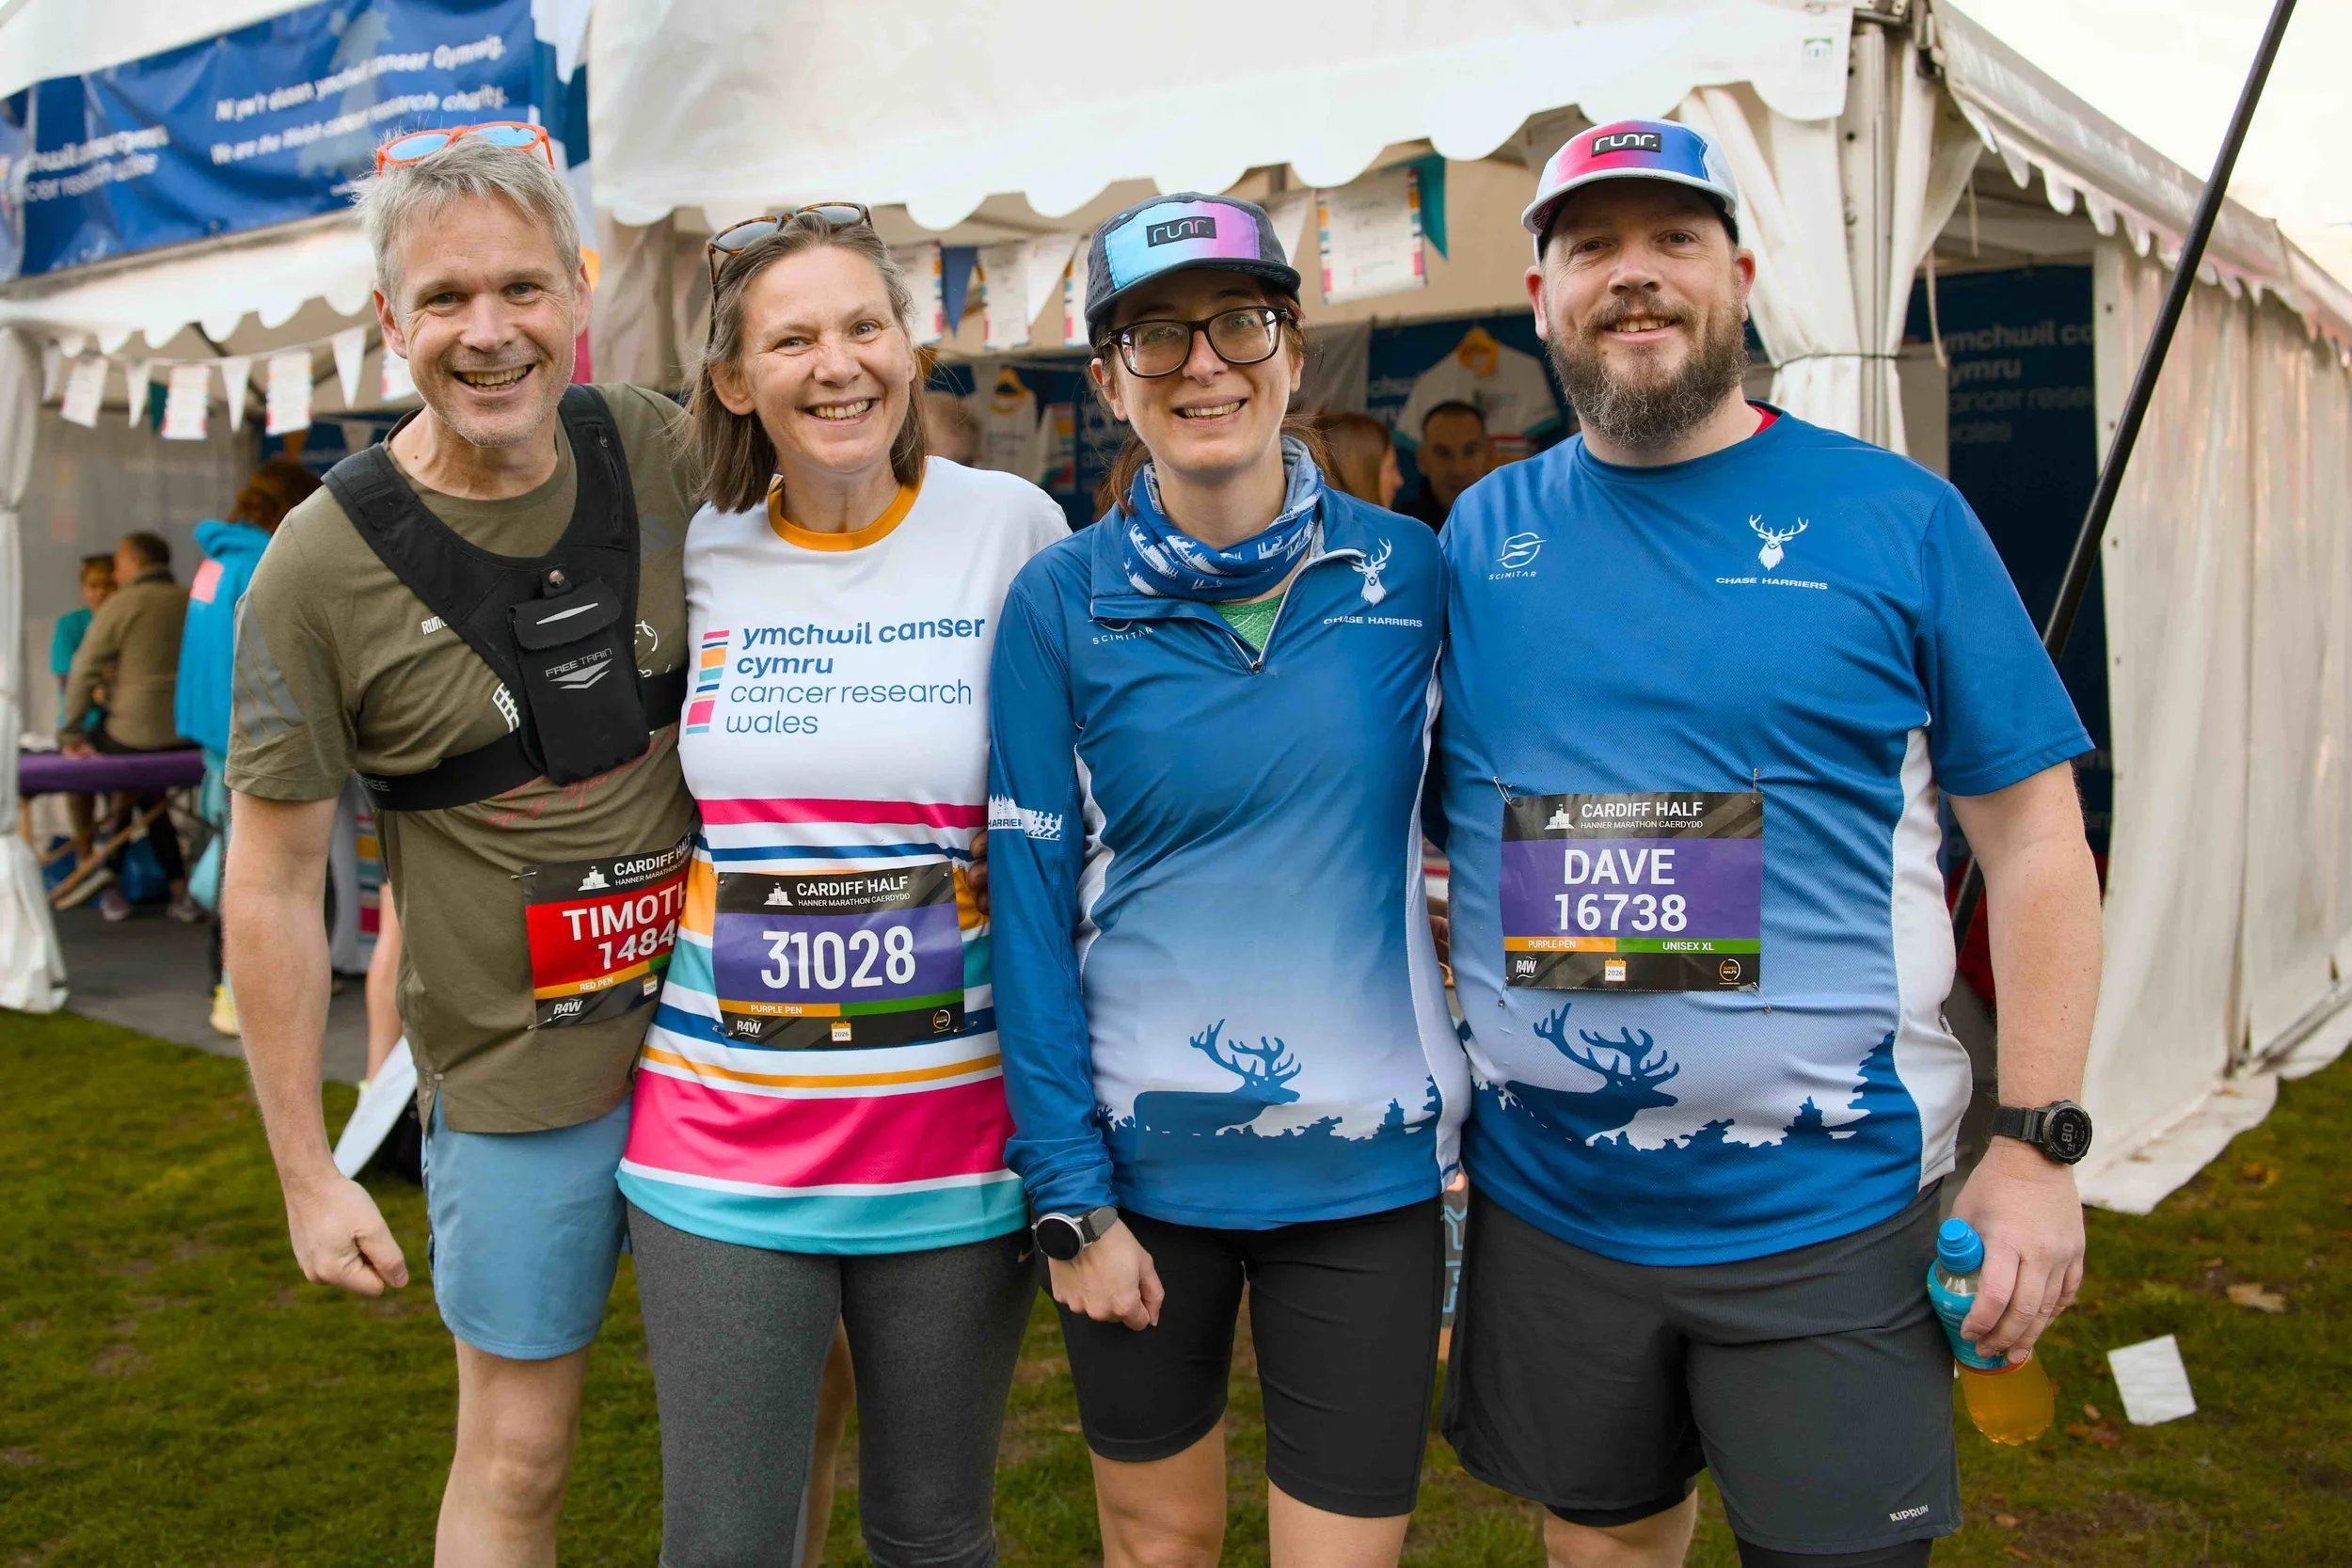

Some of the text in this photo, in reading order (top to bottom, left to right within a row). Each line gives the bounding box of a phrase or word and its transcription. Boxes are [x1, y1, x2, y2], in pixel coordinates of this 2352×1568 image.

[1488, 570, 1537, 580] SCIMITAR
[1715, 577, 1828, 590] CHASE HARRIERS
[1323, 616, 1423, 627] CHASE HARRIERS
[741, 618, 985, 650] ymchwil canser
[1092, 626, 1153, 645] SCIMITAR
[545, 647, 612, 677] FREE TRAIN
[737, 657, 834, 679] cymru
[730, 678, 972, 705] cancer research
[725, 710, 818, 734] wales
[1581, 801, 1703, 818] CARDIFF HALF
[1613, 820, 1658, 829] MARATHON
[1659, 820, 1703, 829] CAERDYDD
[613, 850, 675, 877] CARDIFF
[675, 832, 691, 860] HALF
[614, 864, 678, 886] HANNER MARATHON
[1564, 848, 1676, 885] DAVE
[796, 876, 909, 896] CARDIFF HALF
[798, 893, 911, 907] HANNER MARATHON CAERDYDD
[562, 880, 687, 942] TIMOTH
[1554, 894, 1688, 932] 16738
[597, 917, 677, 970] 1484
[1528, 940, 1576, 949] PURPLE PEN
[1662, 942, 1714, 951] UNISEX XL
[760, 926, 916, 990] 31028
[1607, 969, 1624, 977] 2026
[580, 976, 613, 991] RED PEN
[751, 1004, 803, 1014] PURPLE PEN
[1889, 1505, 1929, 1522] KIPRUN
